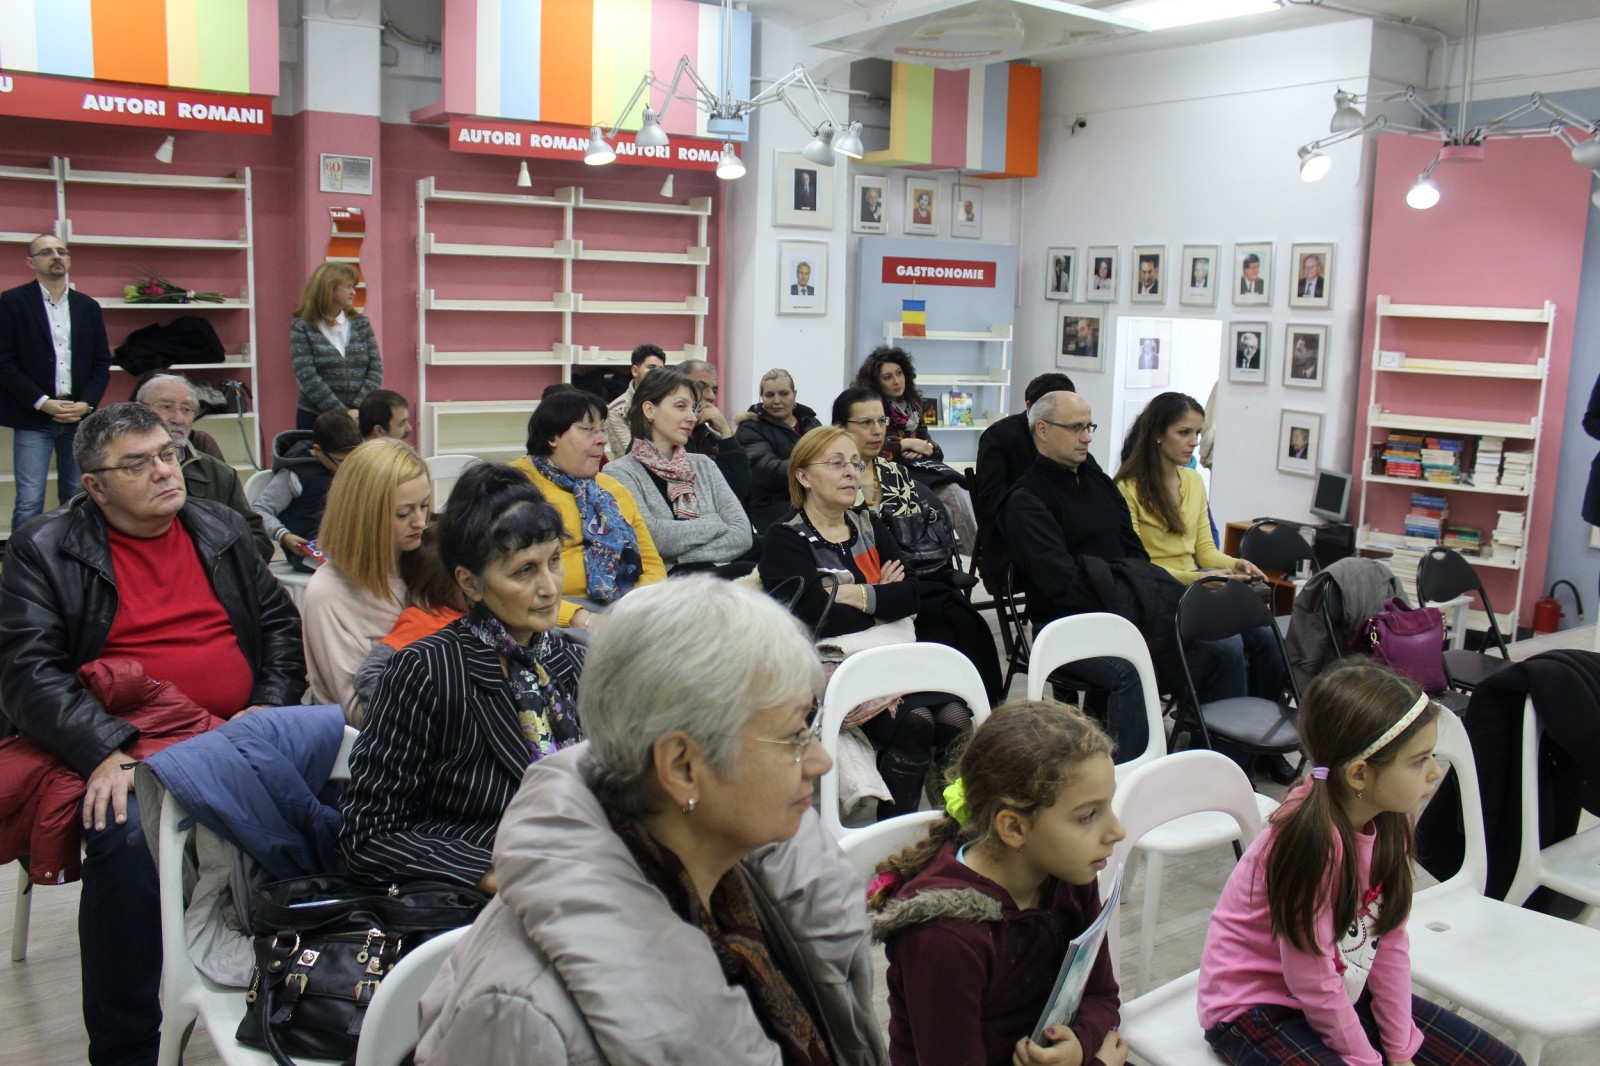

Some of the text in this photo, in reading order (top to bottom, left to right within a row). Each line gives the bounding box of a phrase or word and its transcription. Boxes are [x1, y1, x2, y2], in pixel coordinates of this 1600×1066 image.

[83, 94, 264, 124] AUTORI ROMANI
[458, 128, 590, 151] AUTORI ROMAN
[615, 141, 724, 163] AUTORI ROMA
[896, 265, 984, 280] GASTRONOMIE
